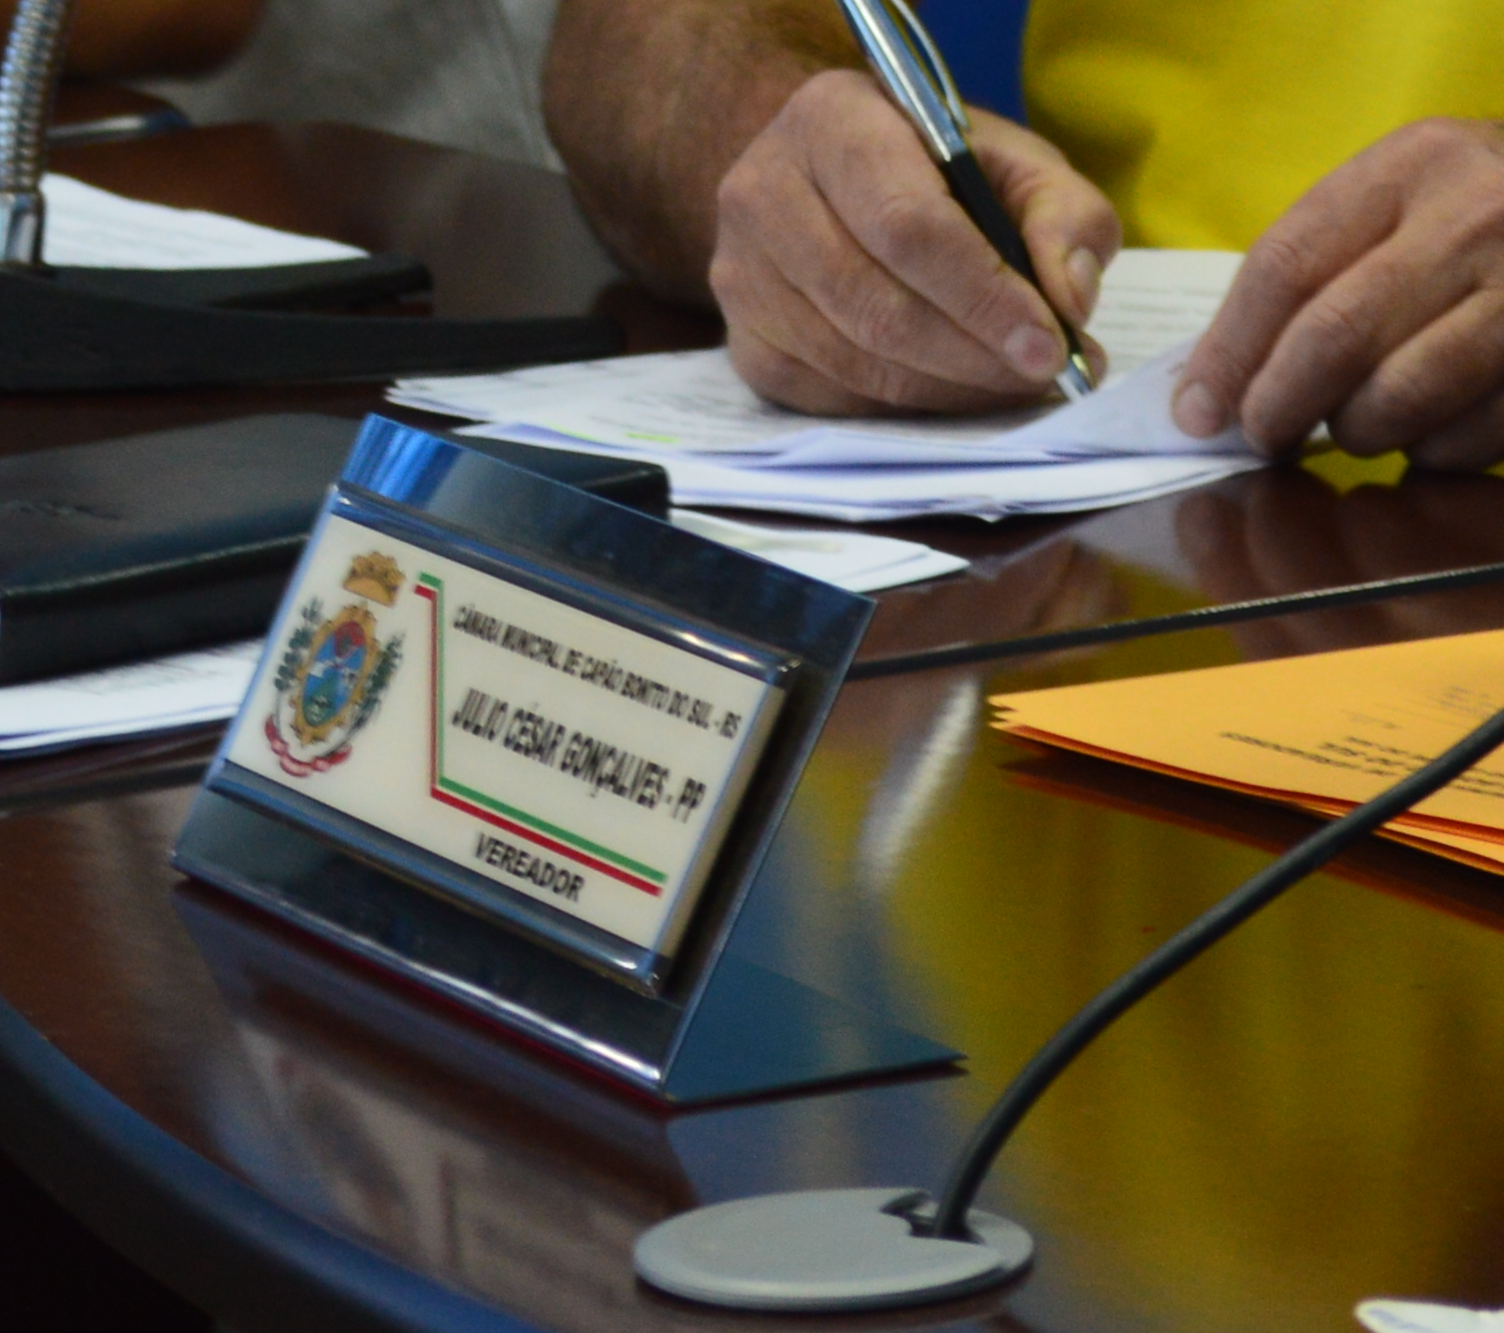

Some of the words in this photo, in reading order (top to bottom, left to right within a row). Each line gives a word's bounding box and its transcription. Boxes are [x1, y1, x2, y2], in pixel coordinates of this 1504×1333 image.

[501, 623, 559, 670] MUNICIPAL
[562, 648, 583, 675] DE
[620, 671, 670, 711] BONITO
[667, 689, 689, 719] DO
[687, 698, 714, 730] SUL
[560, 731, 670, 810] GONÇALVES
[671, 776, 708, 824] PP
[473, 832, 585, 902] VEREADOR
